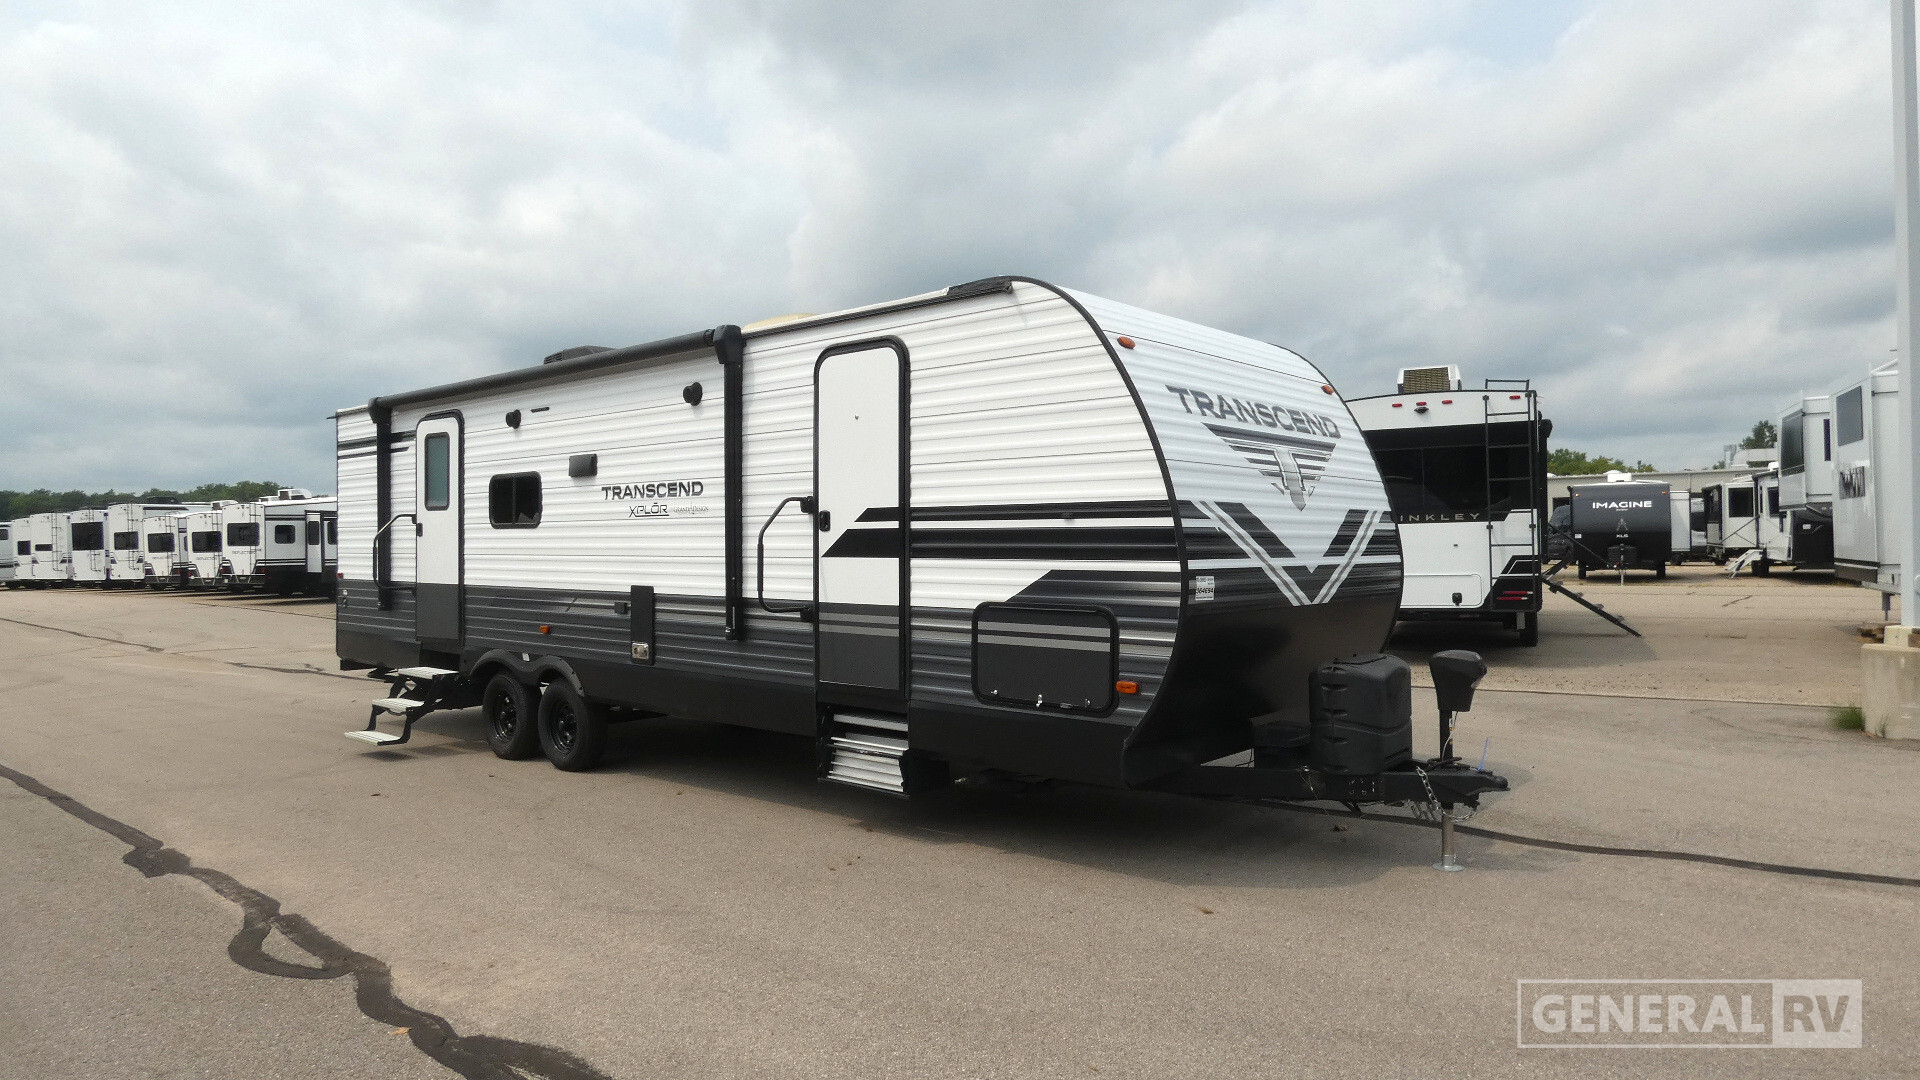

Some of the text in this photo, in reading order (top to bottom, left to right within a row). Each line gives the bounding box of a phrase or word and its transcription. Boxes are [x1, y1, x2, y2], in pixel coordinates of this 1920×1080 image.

[1165, 384, 1342, 439] TRANSCEND
[601, 481, 704, 500] TRANSCEND
[1592, 500, 1652, 509] IMAGINE
[1400, 513, 1480, 522] INKLEY
